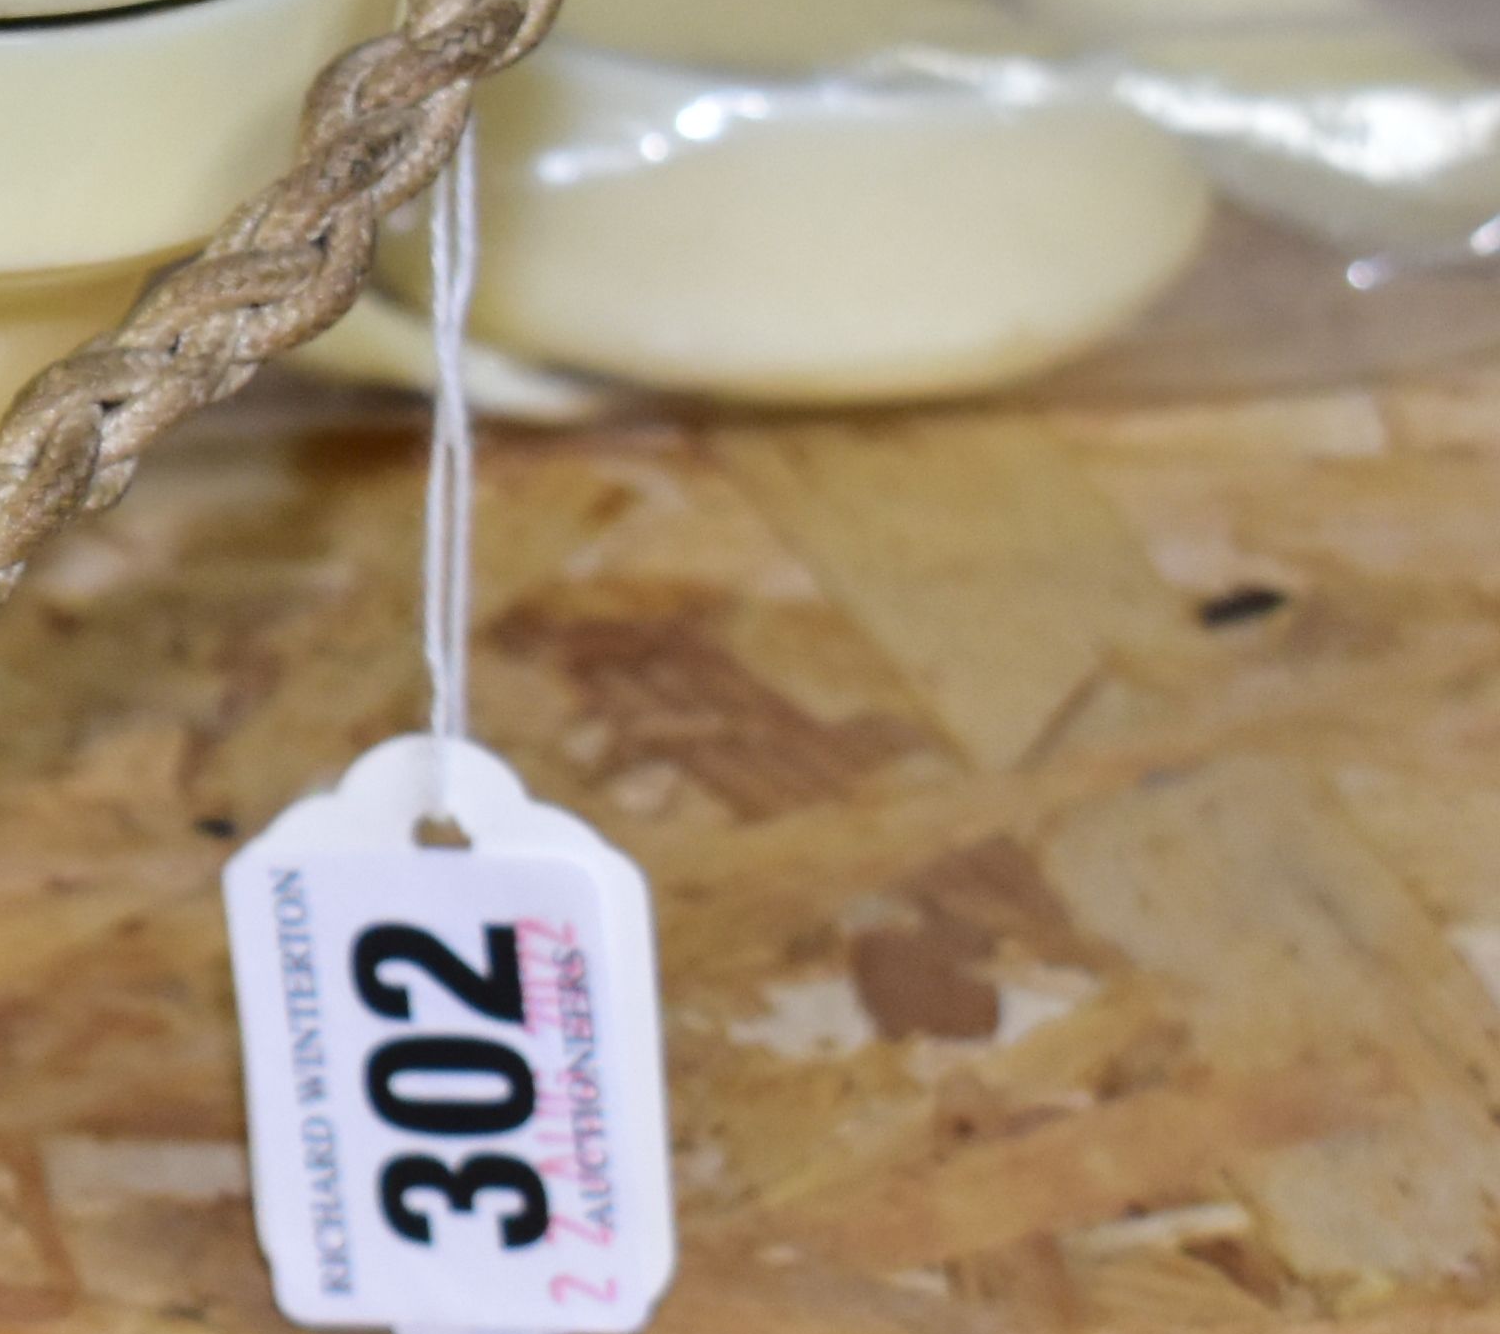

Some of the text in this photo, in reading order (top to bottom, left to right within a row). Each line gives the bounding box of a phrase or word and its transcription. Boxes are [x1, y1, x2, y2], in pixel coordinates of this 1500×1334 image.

[269, 868, 354, 1297] RICHARD WINTERTON
[350, 919, 550, 1252] 302
